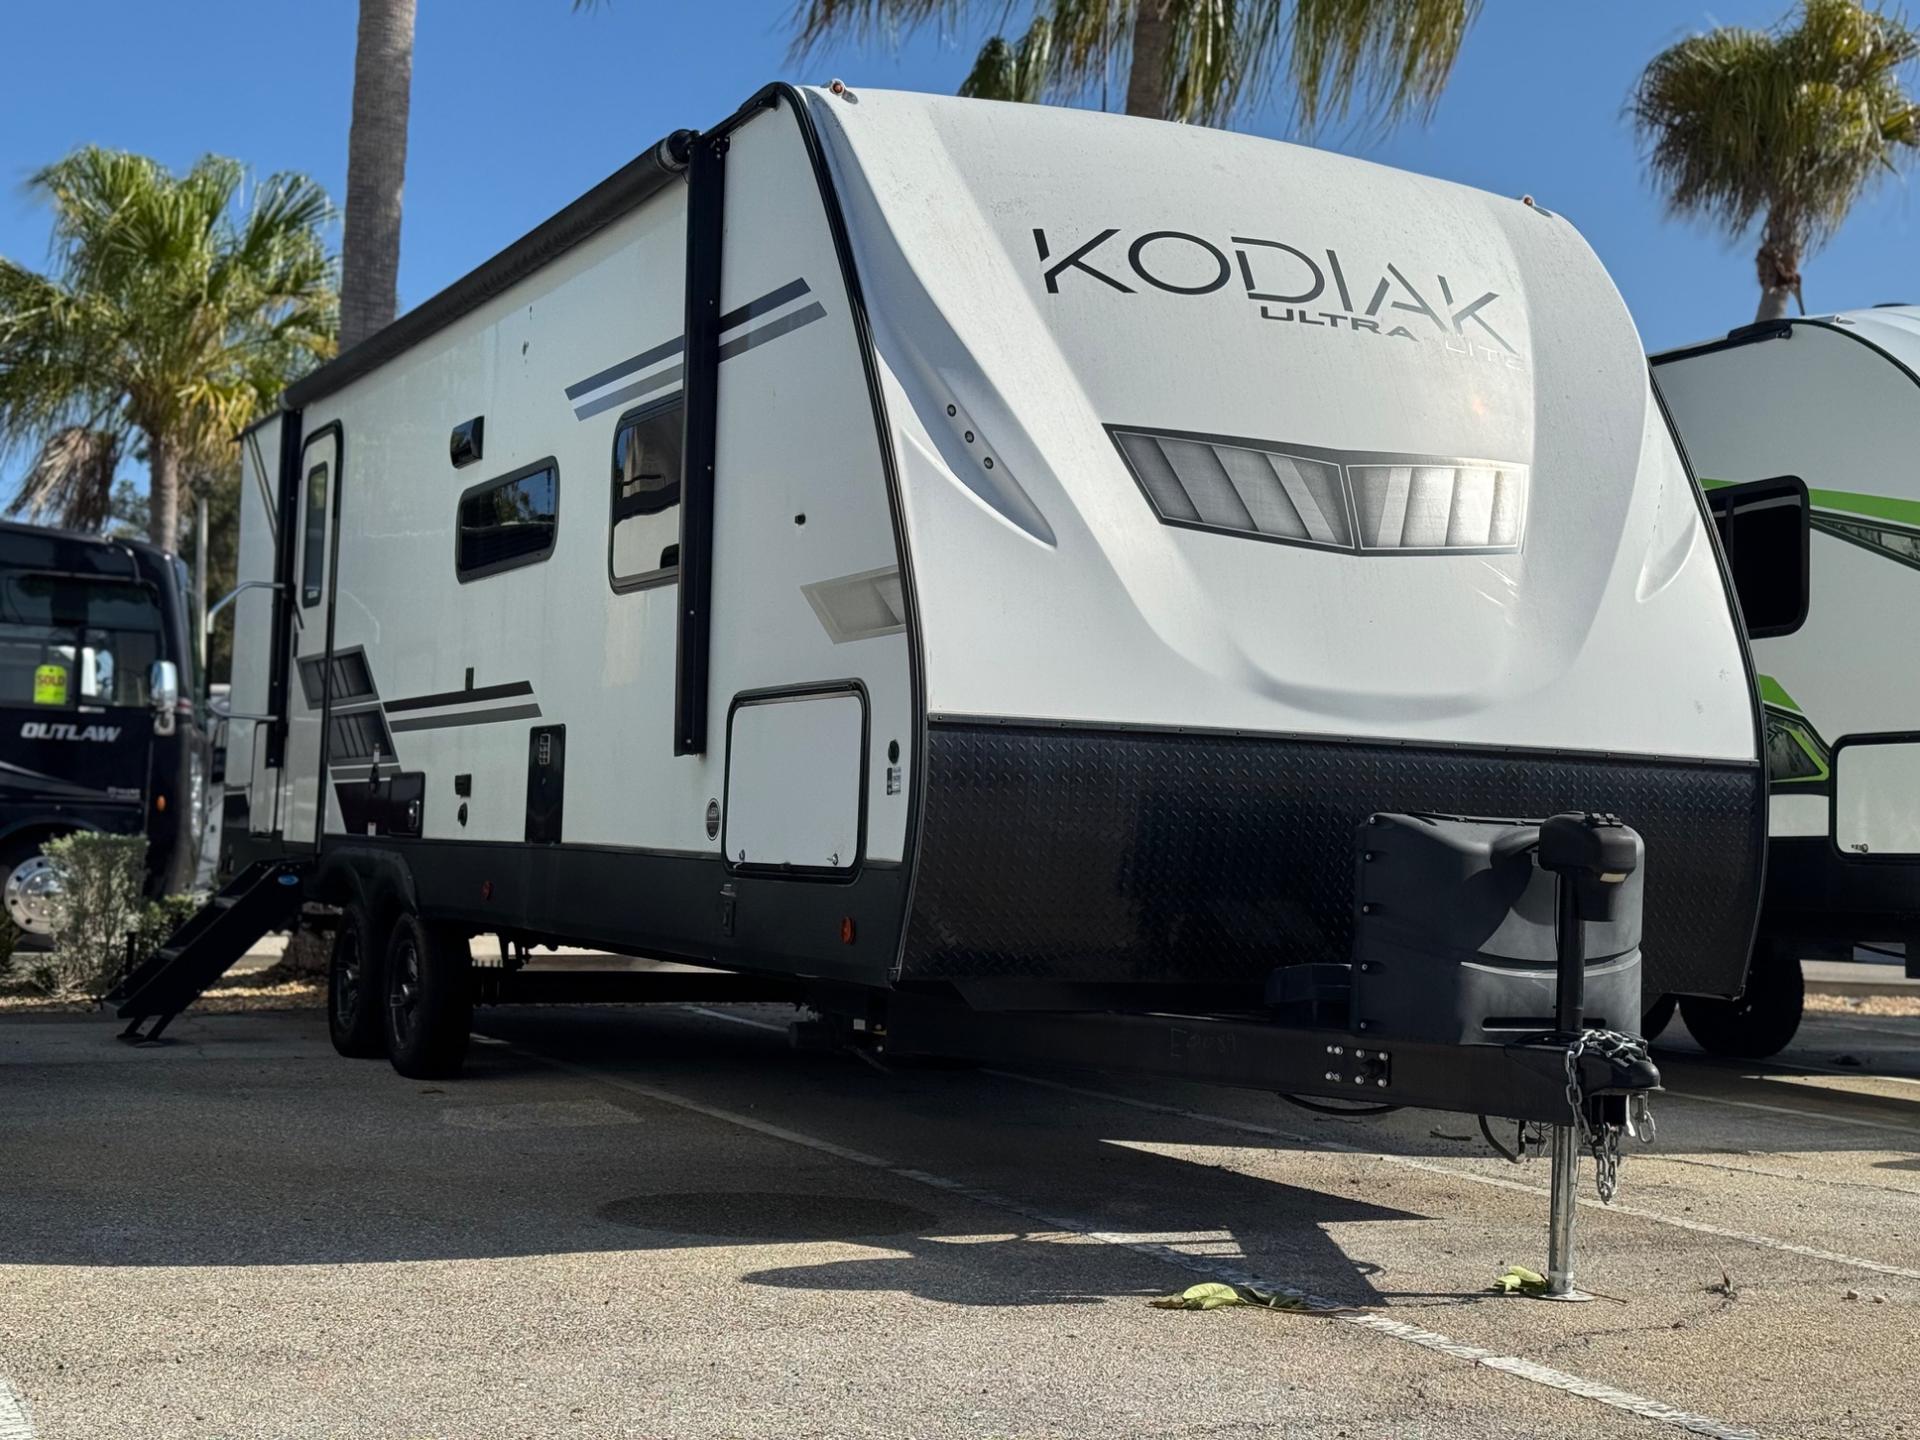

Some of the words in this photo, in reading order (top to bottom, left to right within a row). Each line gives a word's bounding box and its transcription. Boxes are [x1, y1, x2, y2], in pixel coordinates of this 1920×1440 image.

[1031, 227, 1522, 358] KODIAK
[1259, 305, 1420, 342] ULTRA
[36, 674, 66, 687] SOLD
[20, 721, 122, 742] OUTLAW
